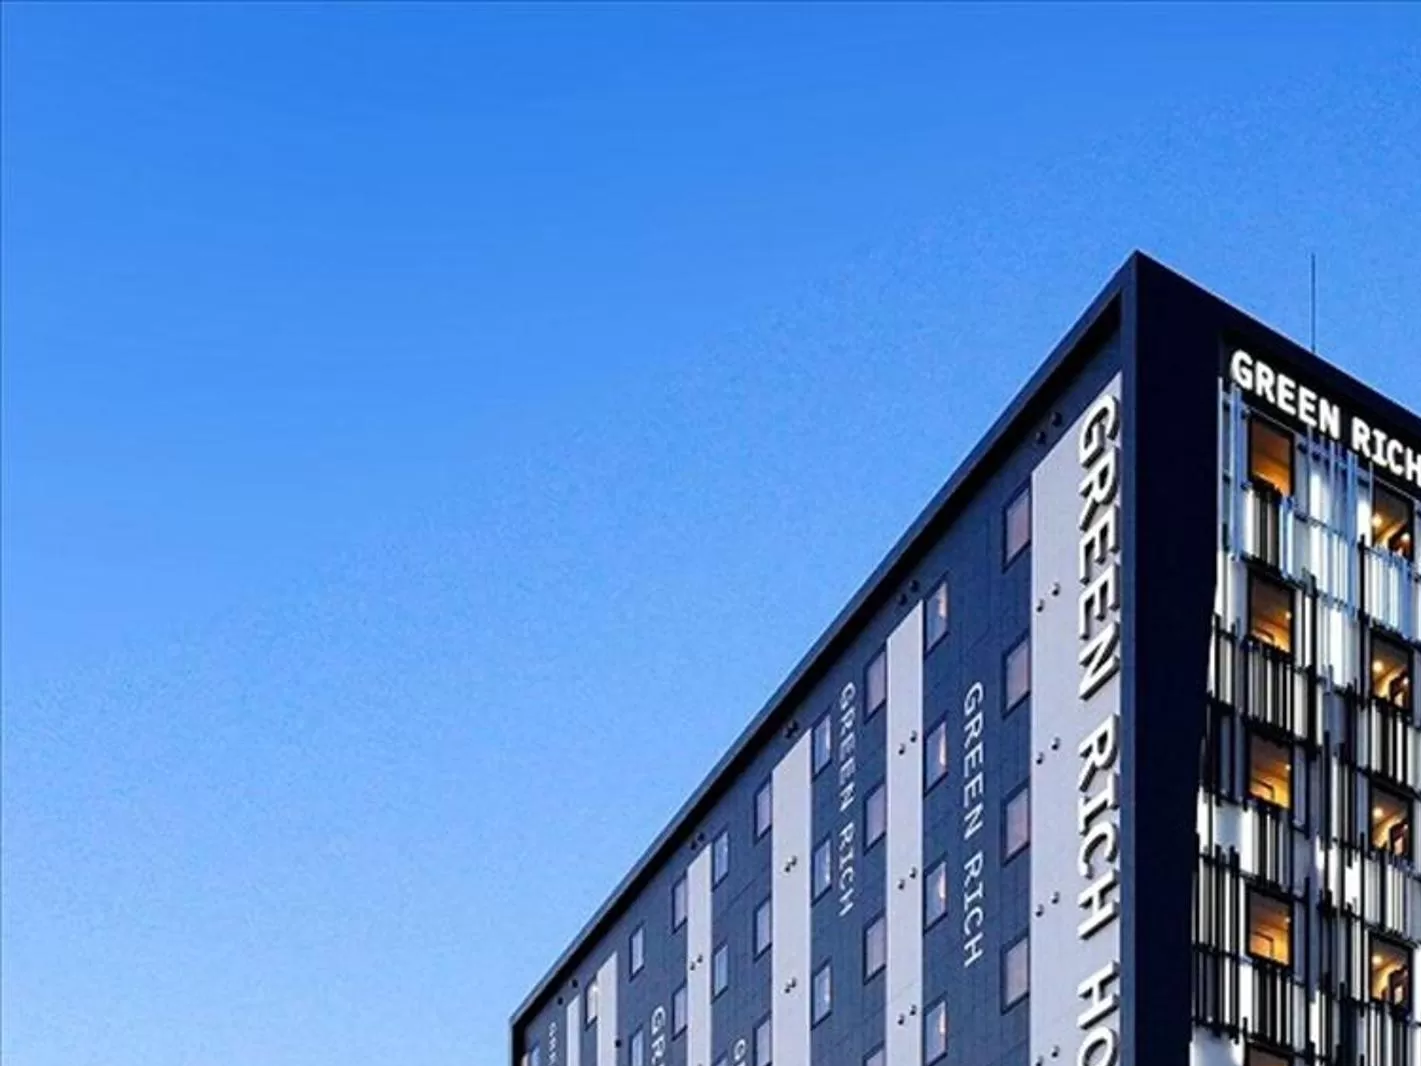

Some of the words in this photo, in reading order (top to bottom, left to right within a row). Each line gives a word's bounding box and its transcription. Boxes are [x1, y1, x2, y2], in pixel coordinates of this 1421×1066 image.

[1230, 349, 1341, 441] GREEN
[1077, 394, 1121, 701] GREEN
[838, 682, 856, 812] GREEN
[963, 681, 985, 840] GREEN
[838, 821, 856, 917] RICH
[1077, 713, 1120, 941] RICH
[963, 851, 985, 968] RICH
